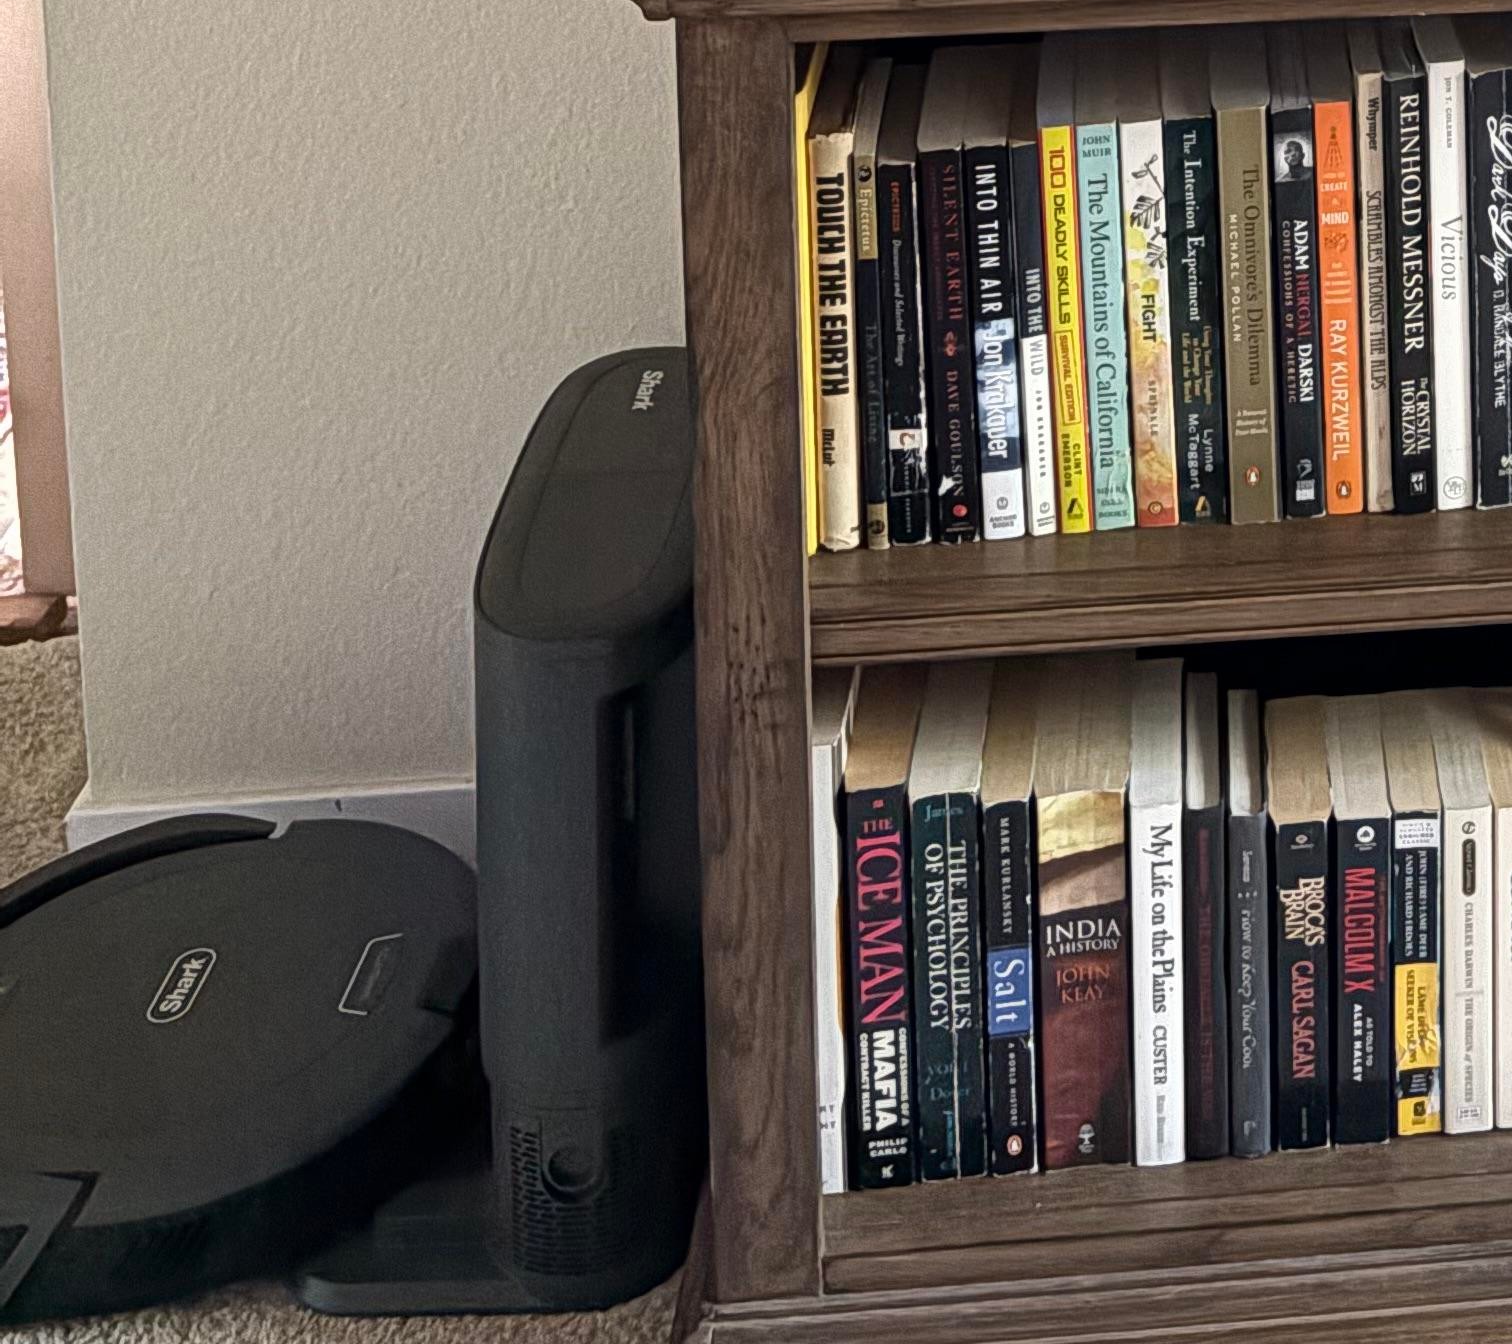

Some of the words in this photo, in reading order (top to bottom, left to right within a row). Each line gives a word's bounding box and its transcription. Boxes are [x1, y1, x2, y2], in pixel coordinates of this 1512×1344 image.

[1048, 146, 1065, 188] 100
[1082, 136, 1110, 146] JOHN
[1083, 147, 1112, 158] MUIR
[1399, 93, 1422, 225] REINHOLD
[817, 174, 845, 252] TOUCH
[975, 165, 995, 210] INTO
[1088, 173, 1107, 215] The
[978, 220, 998, 269] THIN
[1050, 194, 1068, 261] DEADLY
[818, 258, 846, 306] THE
[1087, 222, 1109, 339] Mountains
[1440, 216, 1463, 300] Vicious
[980, 278, 1000, 313] AIR
[1055, 267, 1070, 325] SKILLS
[1141, 294, 1156, 342] FIGHT
[1402, 234, 1424, 354] MESSNER
[821, 315, 849, 396] EARTH
[1094, 337, 1108, 361] of
[631, 369, 663, 412] Shark
[1094, 370, 1114, 469] California
[856, 836, 901, 902] ICE
[1046, 918, 1122, 942] INDIA
[1344, 867, 1376, 965] MALCOLM
[159, 956, 205, 1015] Shark
[858, 918, 904, 1025] MAN
[992, 958, 1026, 1022] Salt
[1346, 972, 1375, 994] X
[871, 1030, 895, 1132] MAFIA
